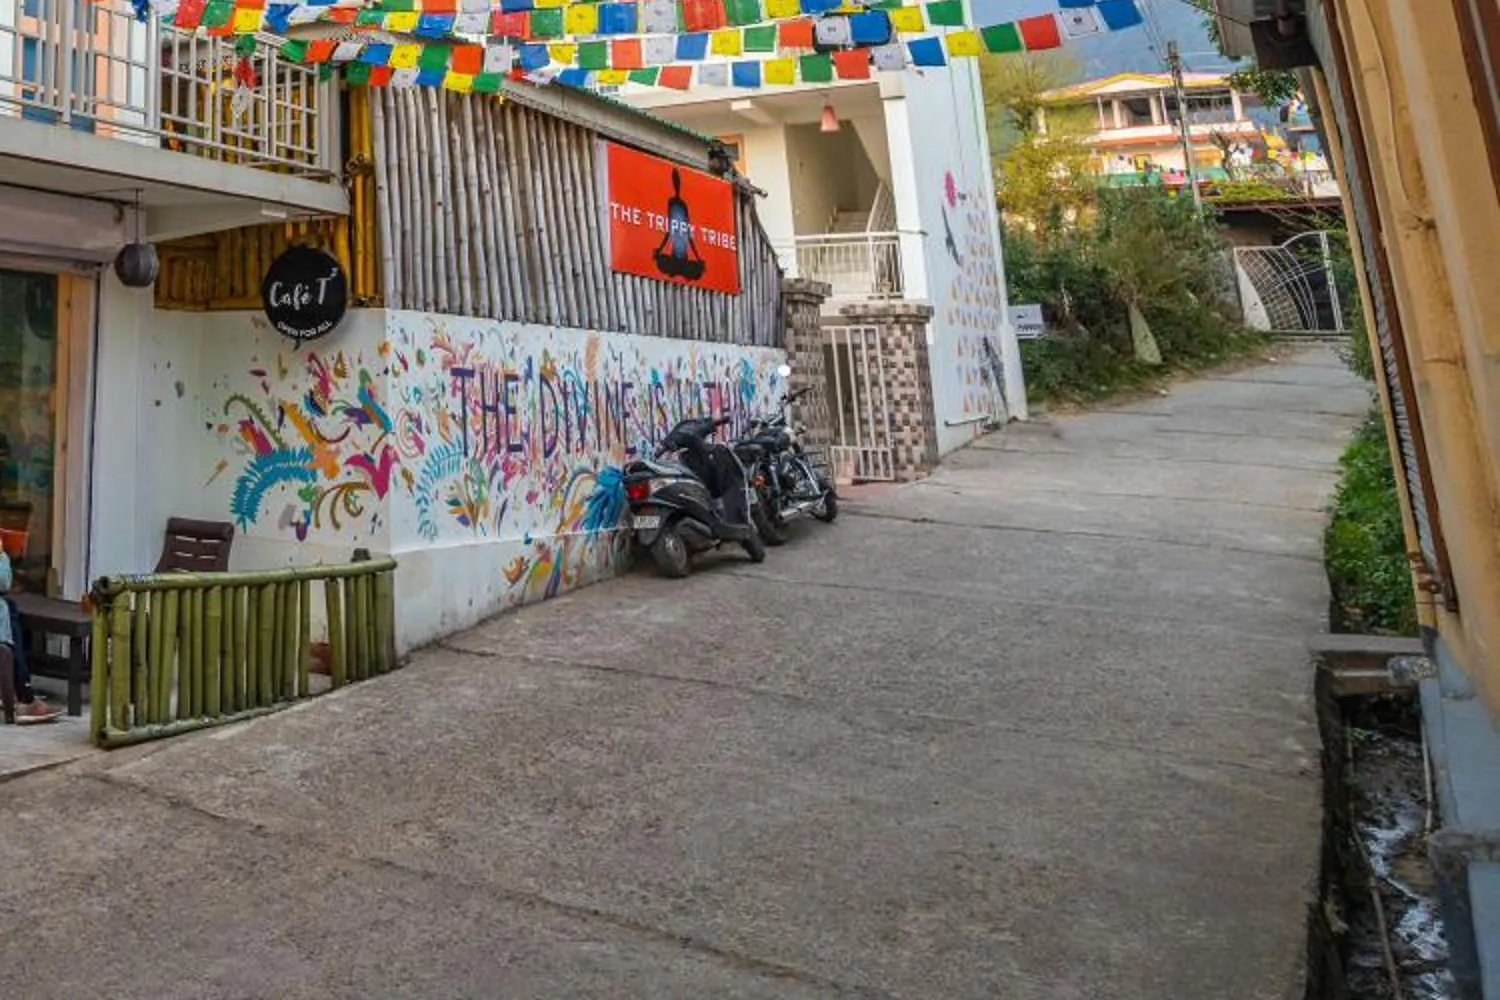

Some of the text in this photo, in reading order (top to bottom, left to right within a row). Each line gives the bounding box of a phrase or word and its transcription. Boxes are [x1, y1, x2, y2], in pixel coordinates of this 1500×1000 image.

[611, 202, 737, 251] THE TRIPPY TRIBE
[300, 328, 316, 337] FOR
[450, 367, 521, 457] THE
[539, 372, 637, 457] DIVINE
